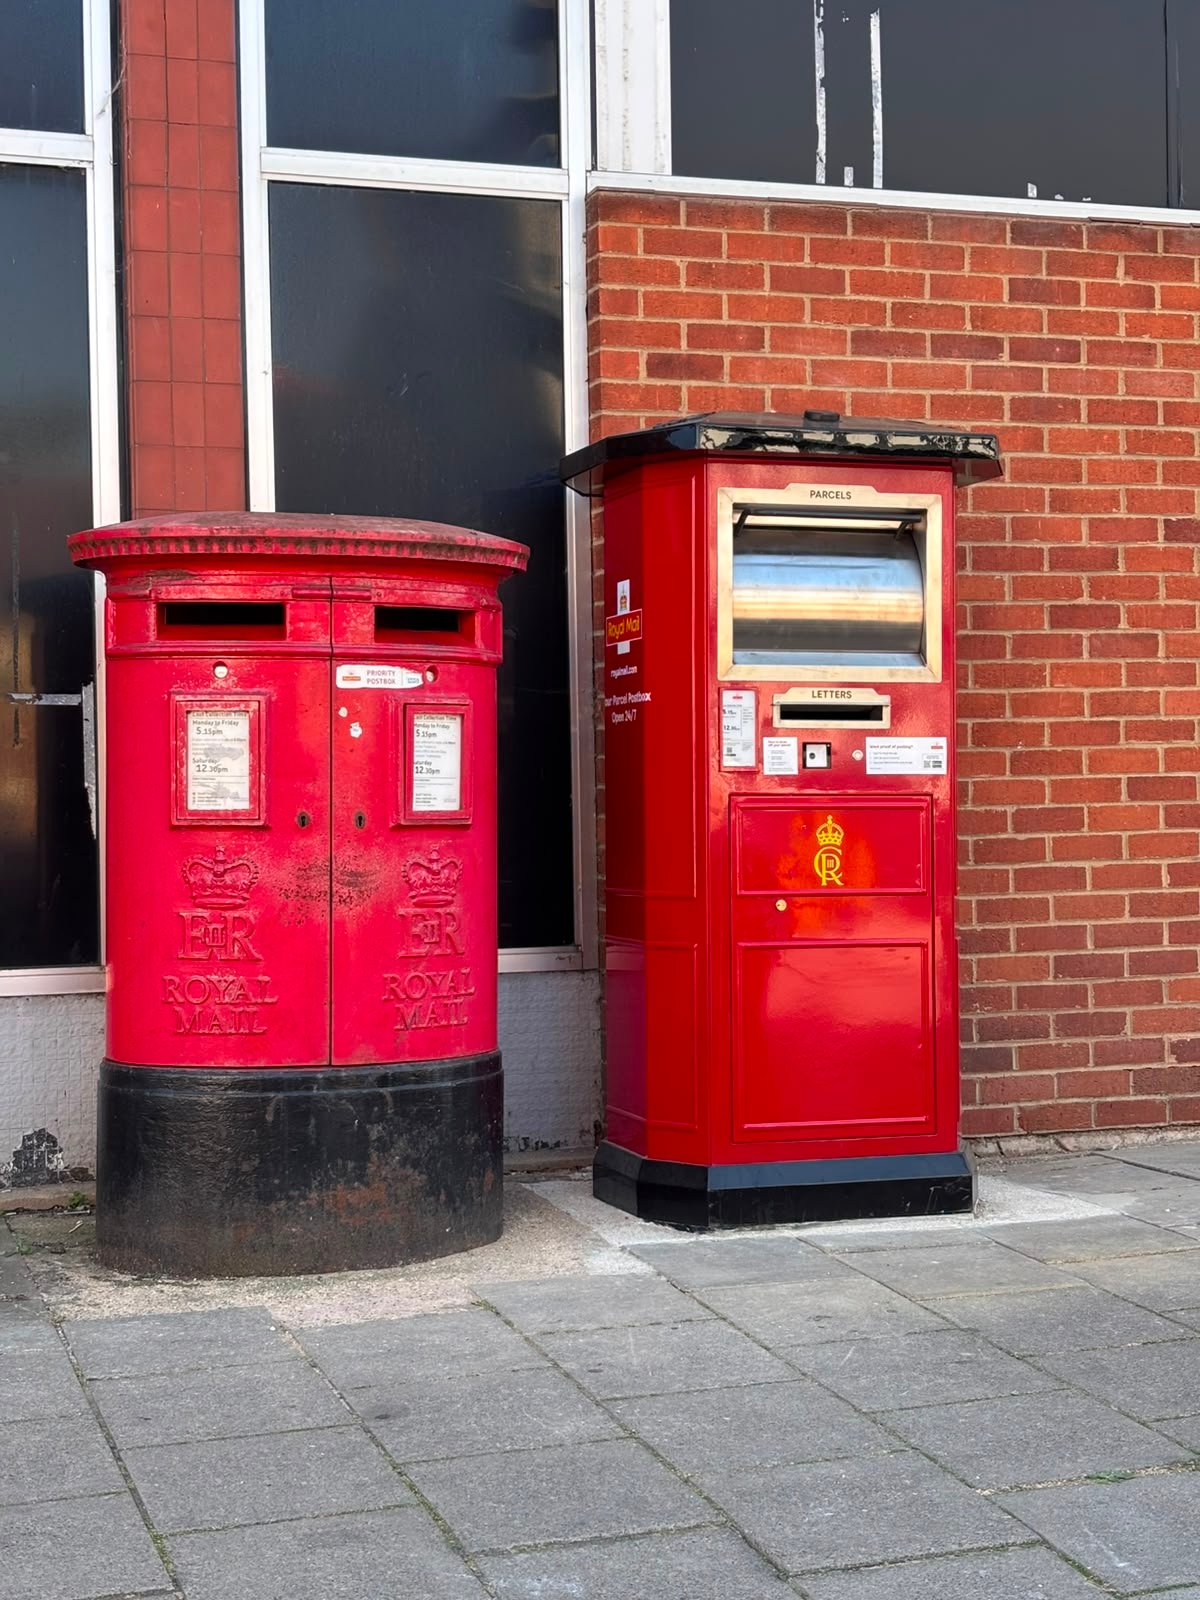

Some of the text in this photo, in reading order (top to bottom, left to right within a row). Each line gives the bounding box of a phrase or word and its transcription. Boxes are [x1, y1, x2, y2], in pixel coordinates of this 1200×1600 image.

[810, 490, 852, 500] PARCELS
[608, 615, 640, 639] Royal Mail
[613, 693, 628, 705] Parcel
[628, 691, 652, 703] Postbox
[812, 690, 852, 699] LETTERS
[611, 709, 637, 725] Open 24/7
[196, 764, 228, 773] 12.30pm
[415, 766, 440, 775] 12.30pm
[162, 974, 278, 1004] ROYAL
[382, 967, 475, 1000] ROYAL
[173, 1006, 268, 1034] MAIL
[394, 1000, 469, 1031] MAIL
